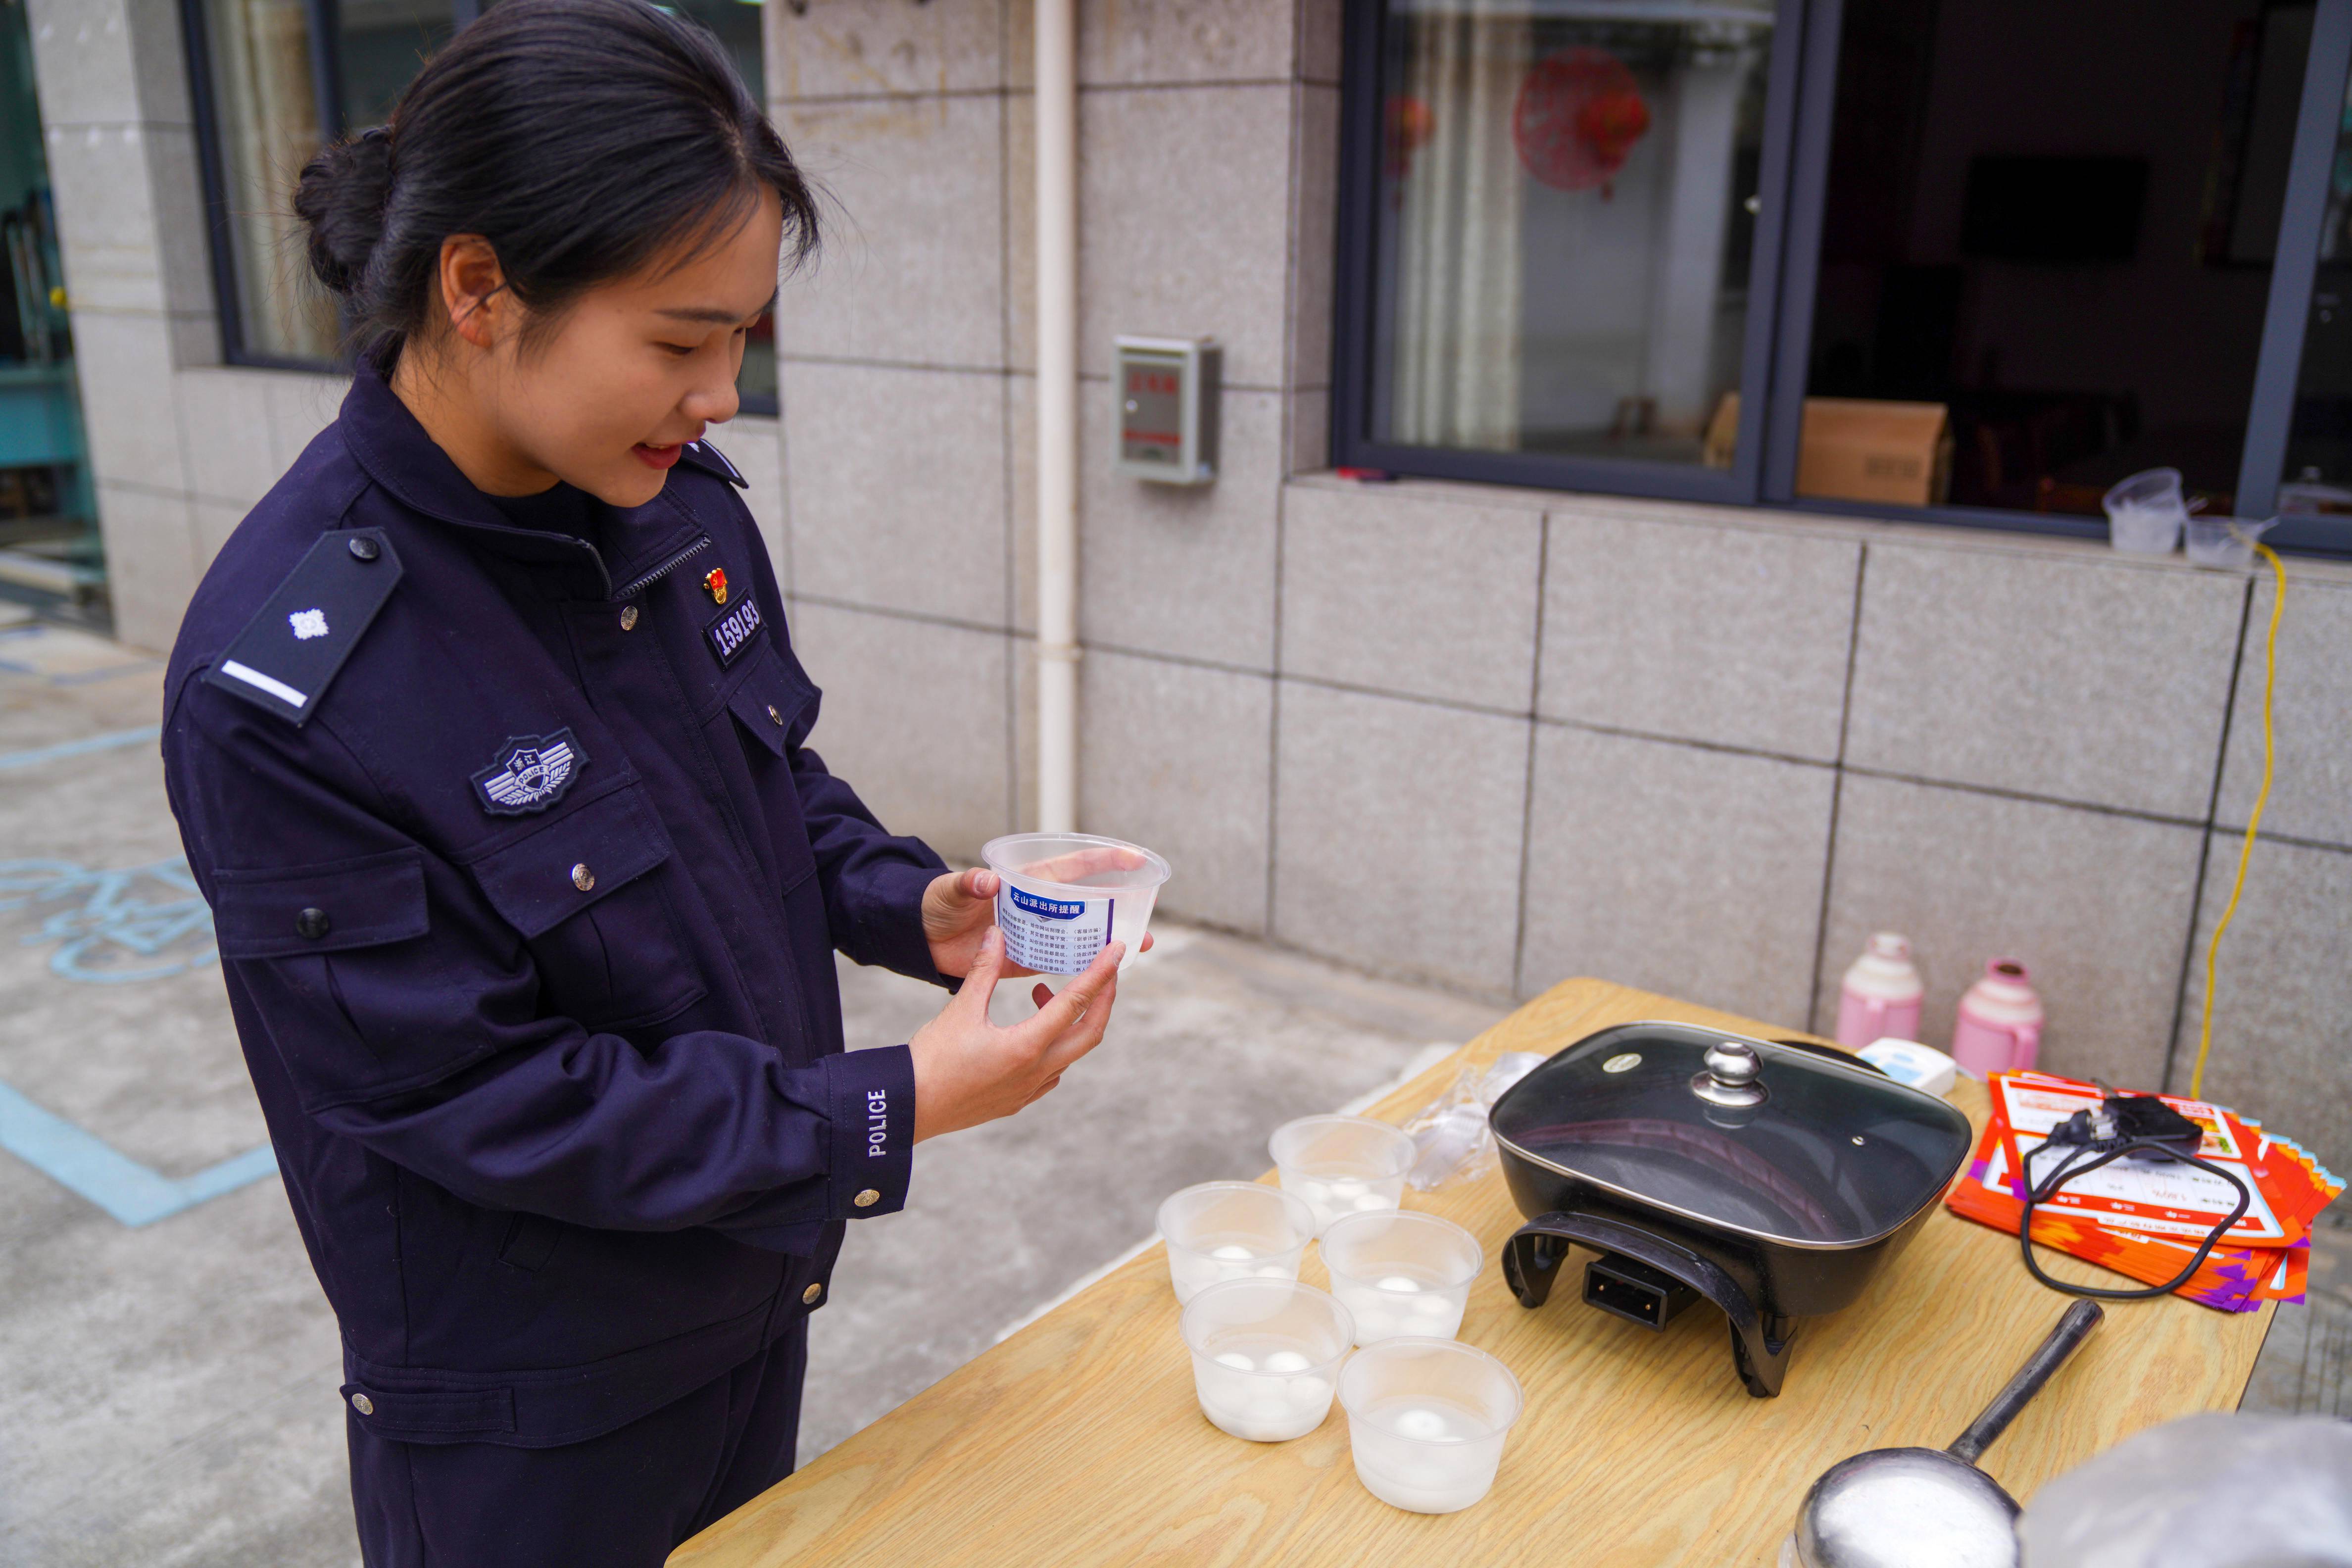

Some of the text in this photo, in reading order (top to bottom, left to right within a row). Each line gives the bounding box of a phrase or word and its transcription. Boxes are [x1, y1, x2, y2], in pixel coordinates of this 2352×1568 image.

[715, 599, 760, 656] 159193
[514, 754, 536, 771] 浙江
[519, 767, 544, 784] POLICE
[1013, 892, 1080, 914] 云山派出所提醒
[868, 1089, 887, 1157] POLICE
